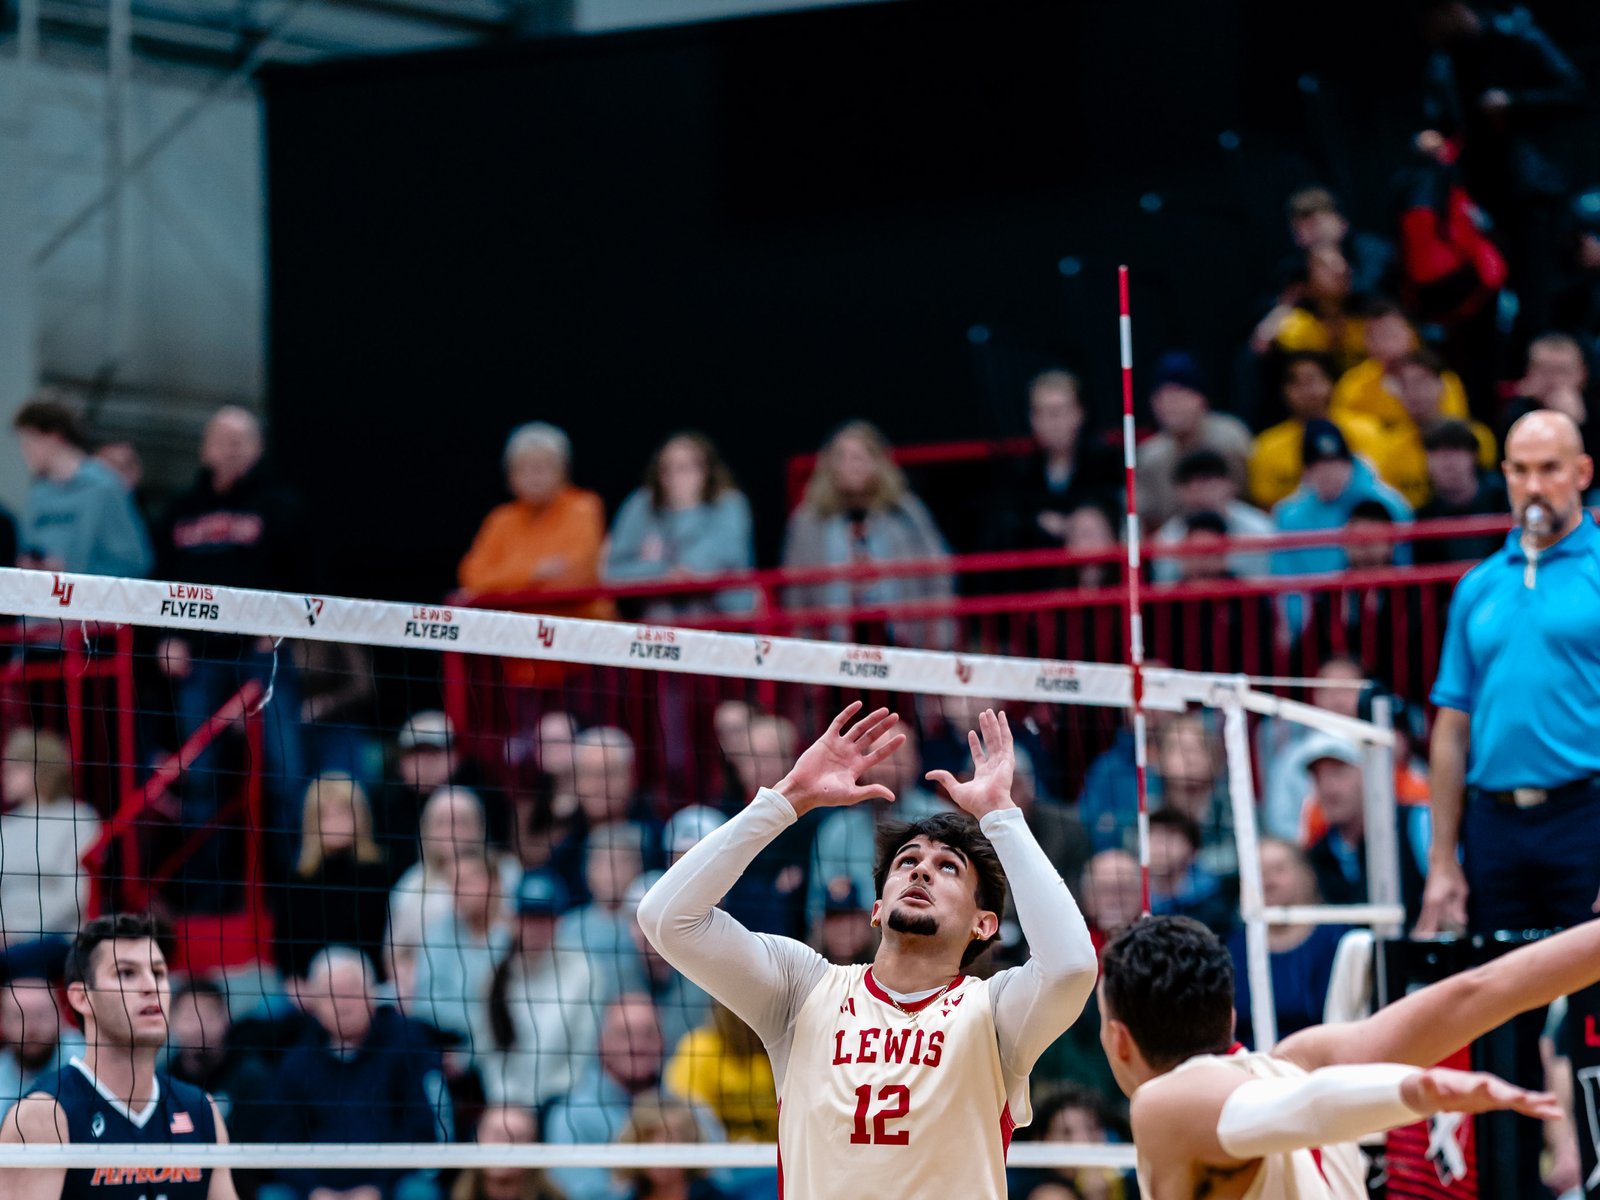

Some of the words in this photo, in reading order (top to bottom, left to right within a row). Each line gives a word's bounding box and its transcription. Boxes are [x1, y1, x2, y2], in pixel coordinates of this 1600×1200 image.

[168, 584, 214, 600] LEWIS
[160, 600, 220, 620] FLYERS
[412, 606, 453, 622] LEWIS
[404, 621, 460, 641] FLYERS
[629, 641, 682, 661] FLYERS
[832, 1027, 945, 1068] LEWIS
[850, 1083, 910, 1146] 12
